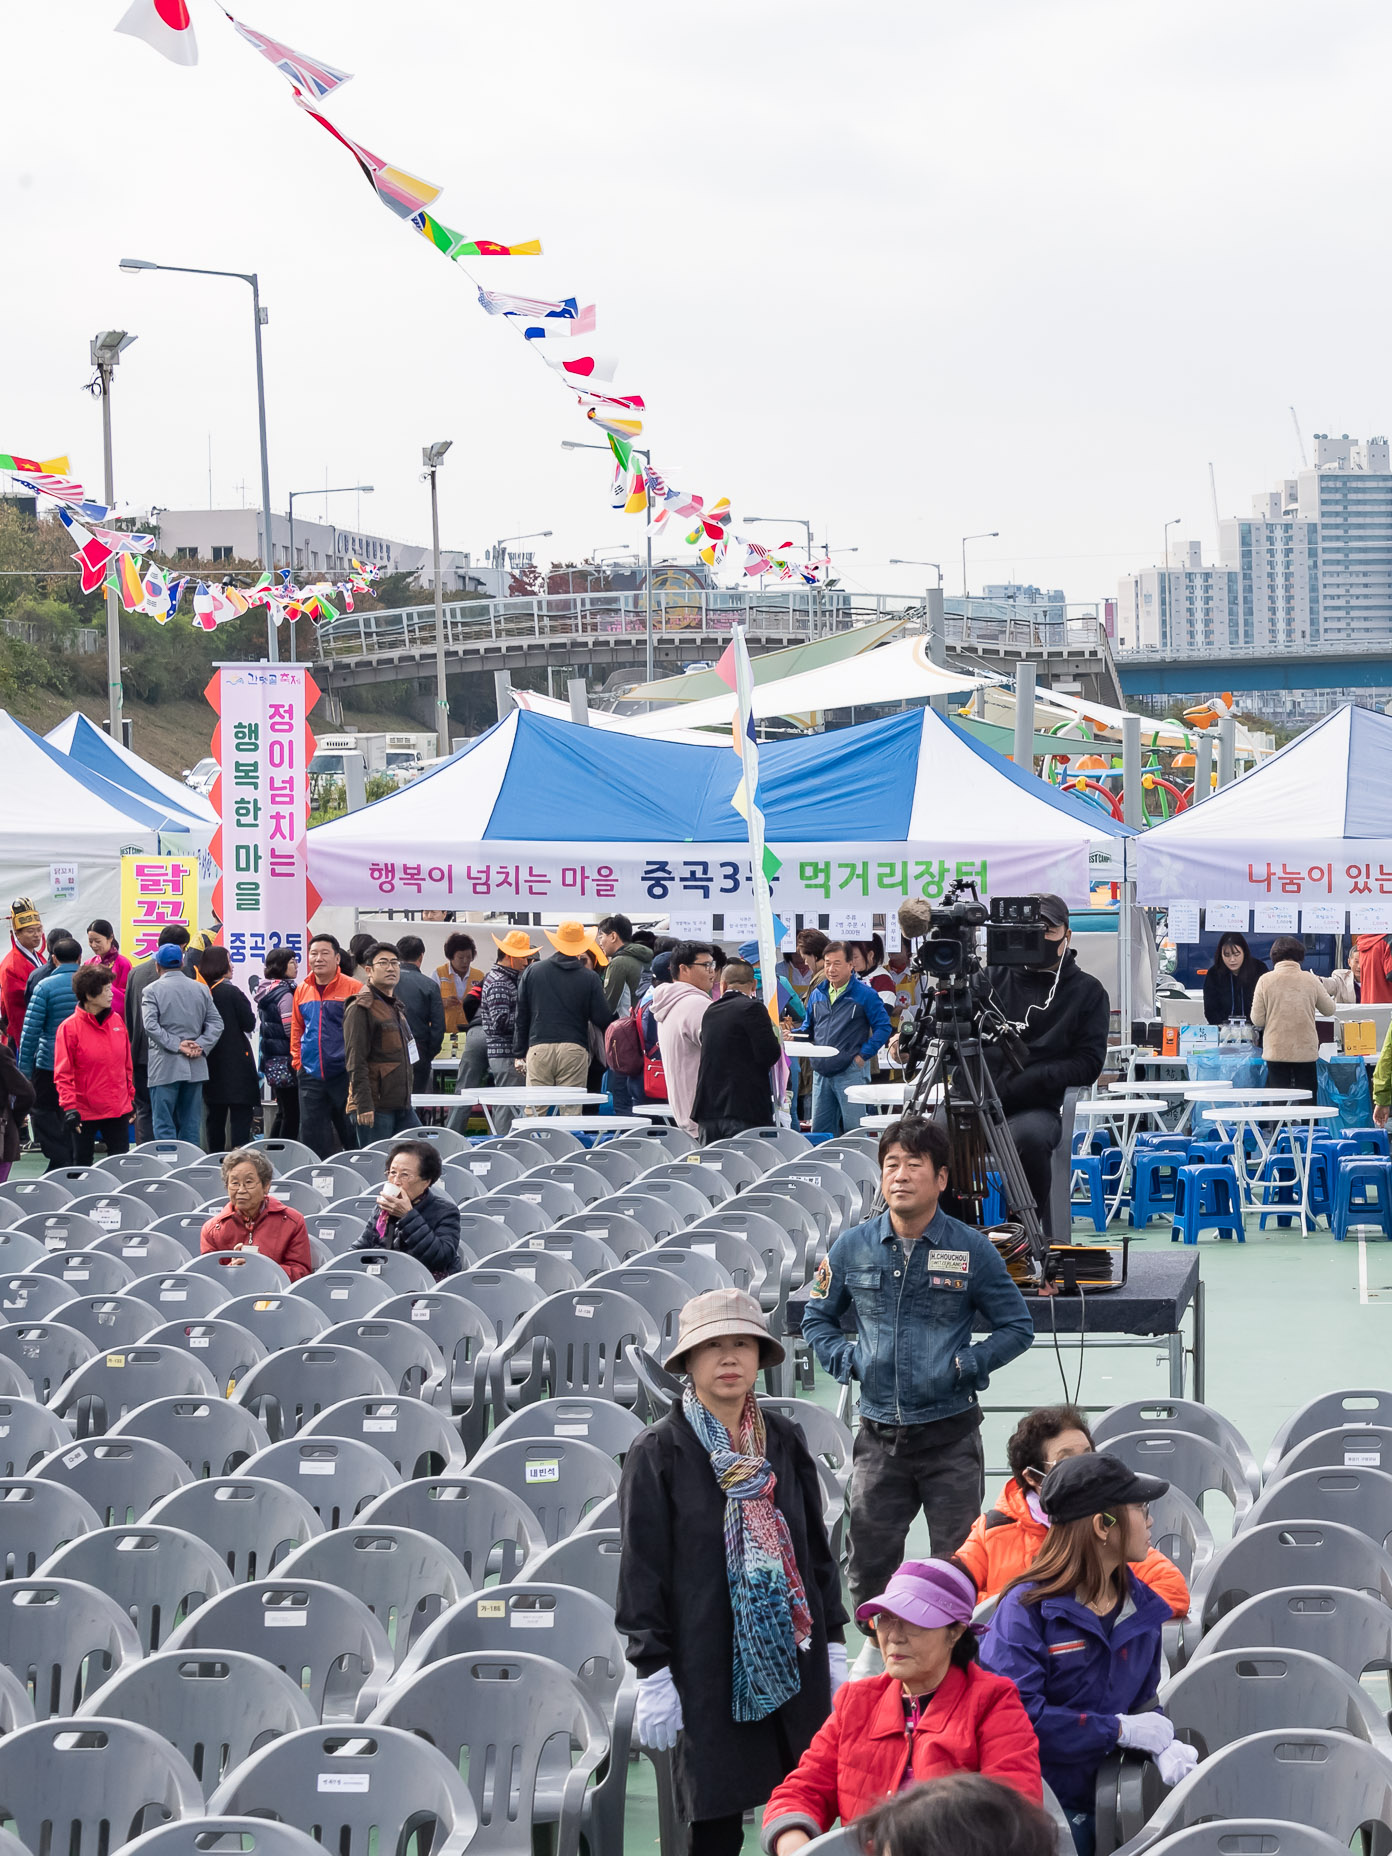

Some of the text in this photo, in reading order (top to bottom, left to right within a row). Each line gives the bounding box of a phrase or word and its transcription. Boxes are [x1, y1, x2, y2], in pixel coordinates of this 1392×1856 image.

[233, 721, 263, 911] 행복한 마을
[368, 862, 453, 894] 행복이
[466, 865, 551, 896] 넘치는
[561, 865, 619, 898] 마을
[799, 860, 987, 899] 먹거리장터
[1248, 862, 1332, 894] 나눔이
[846, 921, 859, 929] 주문
[529, 1467, 556, 1478] 내빈석
